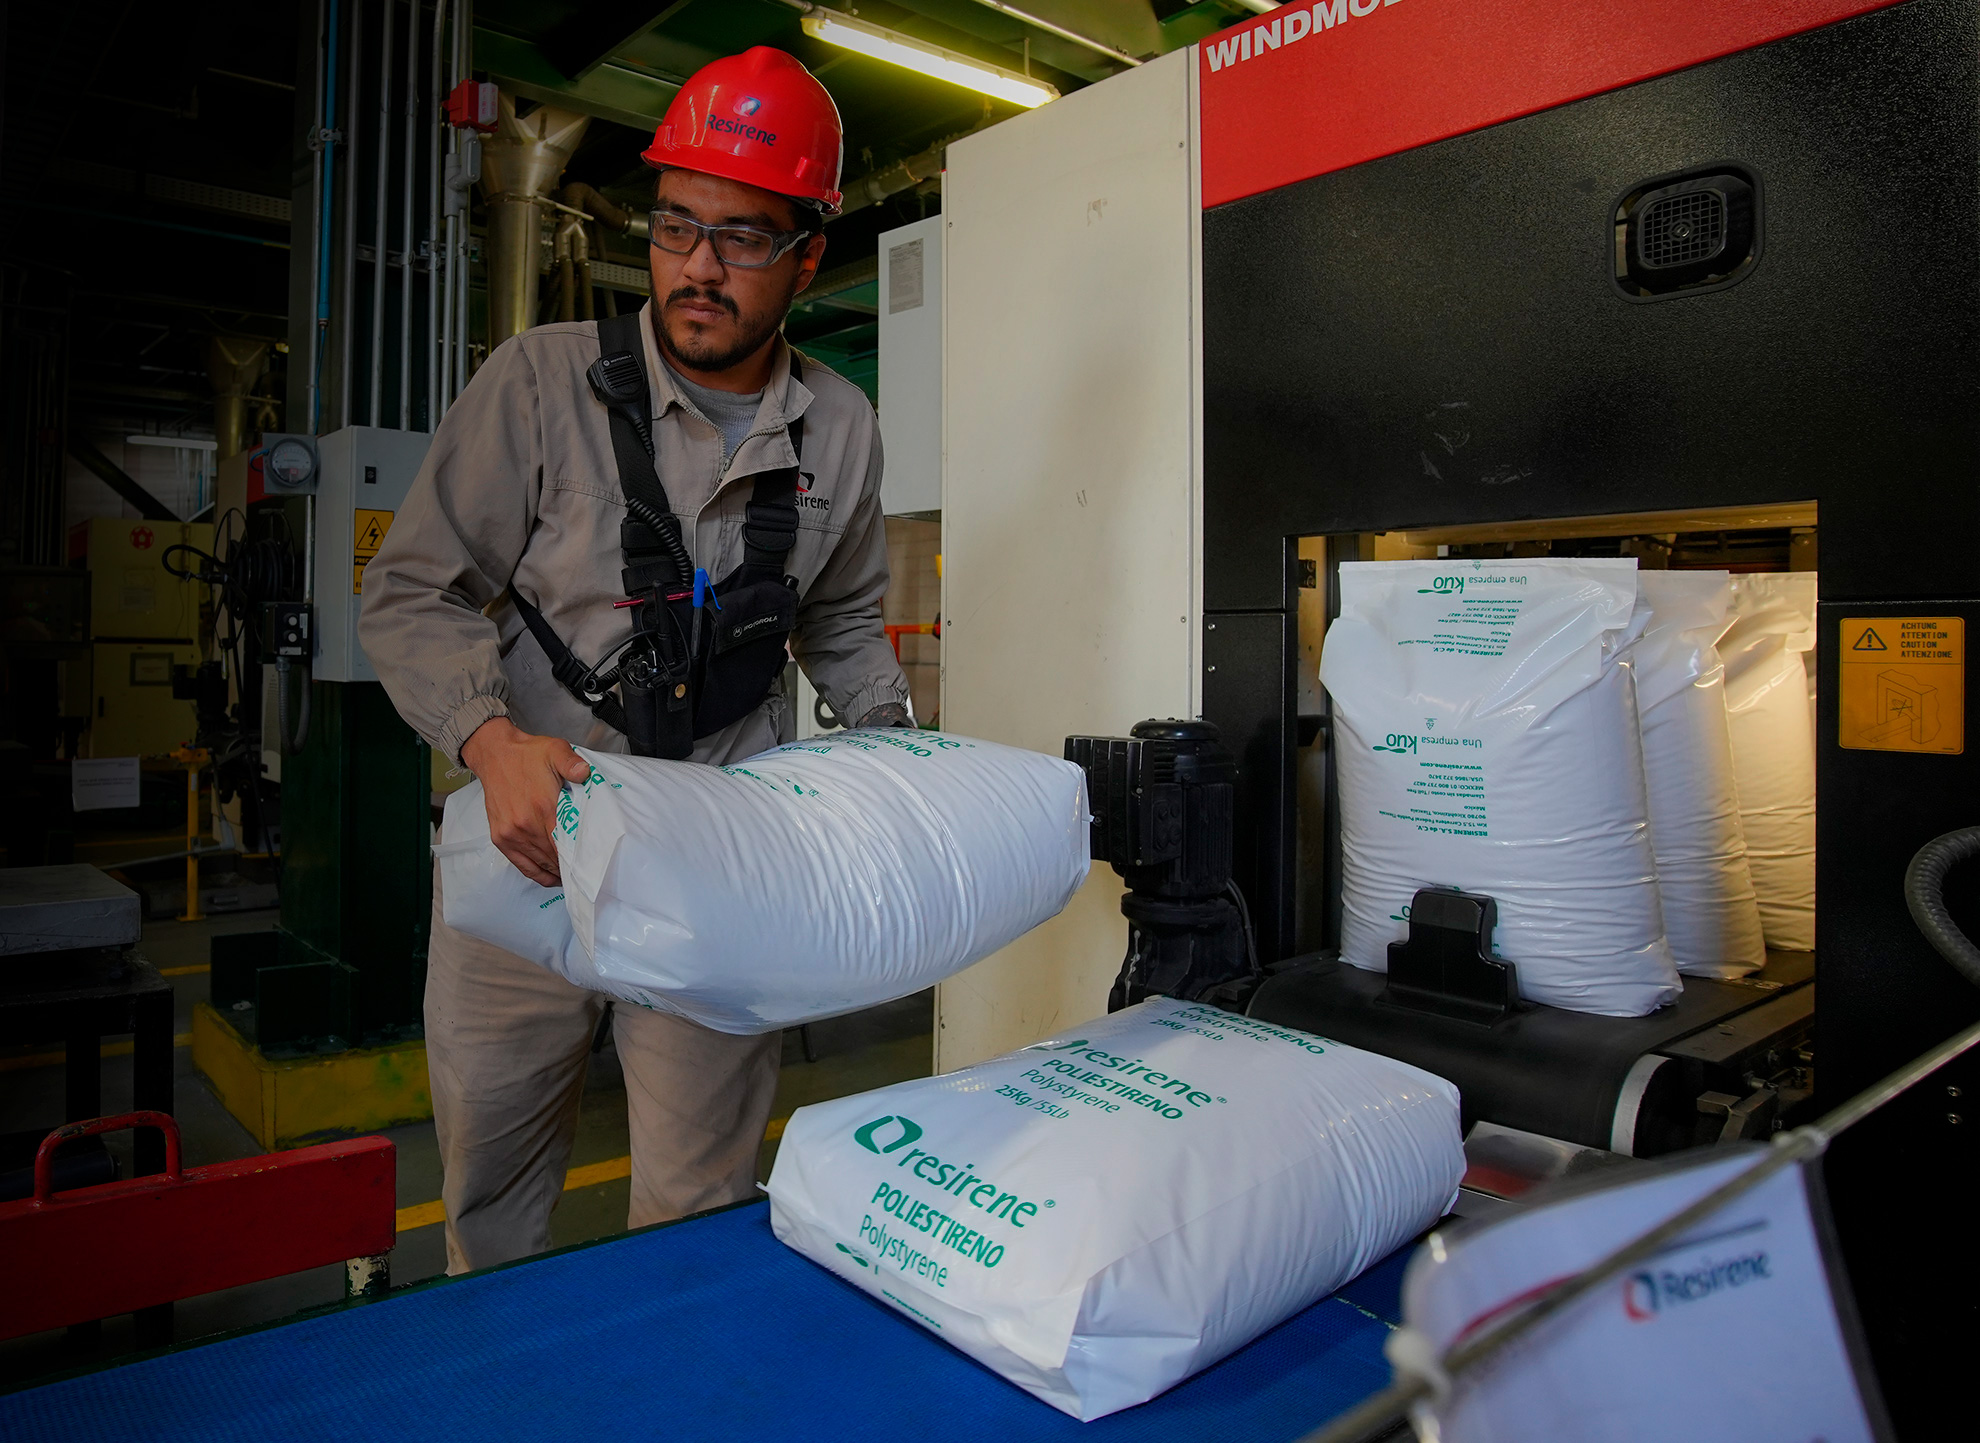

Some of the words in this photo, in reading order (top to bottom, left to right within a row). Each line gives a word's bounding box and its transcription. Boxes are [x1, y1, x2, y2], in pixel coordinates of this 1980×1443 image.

[1206, 0, 1400, 72] WINDMO
[705, 114, 776, 146] Resirene
[794, 492, 830, 510] sirene
[1433, 577, 1464, 594] kuo
[1469, 574, 1506, 584] empresa
[1510, 576, 1527, 585] Una
[1901, 622, 1937, 630] ACHTUNG
[1386, 734, 1417, 754] kuo
[1421, 736, 1459, 745] empresa
[1462, 739, 1482, 748] Una
[1150, 1018, 1187, 1031] 25Kg
[1170, 1010, 1269, 1043] Polystyrene
[1188, 1006, 1325, 1054] POLIESTIRENO
[1020, 1068, 1121, 1114] Polystyrene
[1042, 1059, 1184, 1120] POLIESTIRENO
[1069, 1045, 1212, 1108] resirene
[995, 1084, 1033, 1106] 25Kg
[897, 1148, 1038, 1229] resirene
[871, 1181, 1005, 1269] POLIESTIRENO
[859, 1214, 948, 1288] Polystyrene
[1663, 1250, 1772, 1304] Resirene
